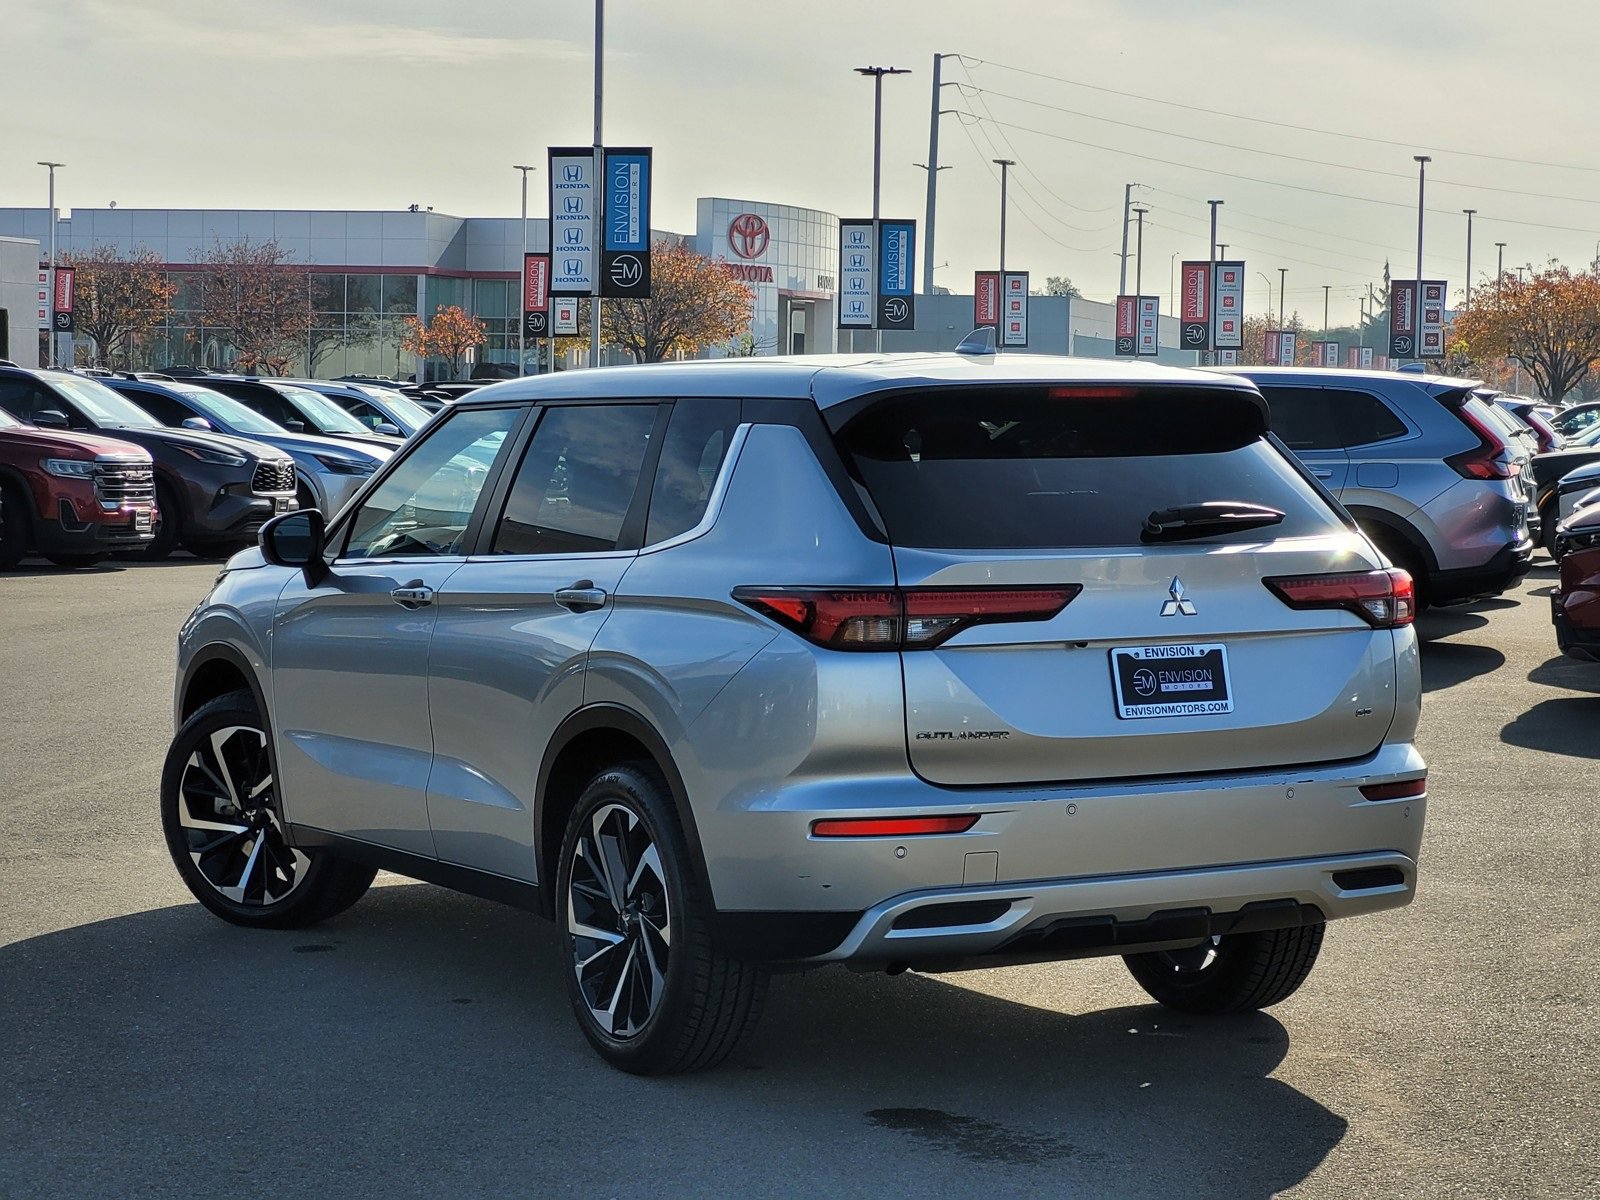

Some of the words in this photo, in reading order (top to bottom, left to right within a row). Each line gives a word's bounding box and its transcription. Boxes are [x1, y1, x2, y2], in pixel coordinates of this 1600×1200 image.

[614, 162, 629, 243] ENVISION
[887, 230, 899, 290] ENVISION
[58, 273, 66, 309] ENVISION
[529, 261, 539, 307] ENVISION
[980, 278, 989, 320] ENVISION
[1187, 270, 1198, 318] ENVISION
[1396, 288, 1406, 331] ENVISION
[1144, 646, 1194, 658] ENVISION
[1158, 669, 1212, 683] ENVISION
[1125, 702, 1229, 717] ENVISIONMOTORS.COM
[916, 731, 1010, 740] OUTLANDER
